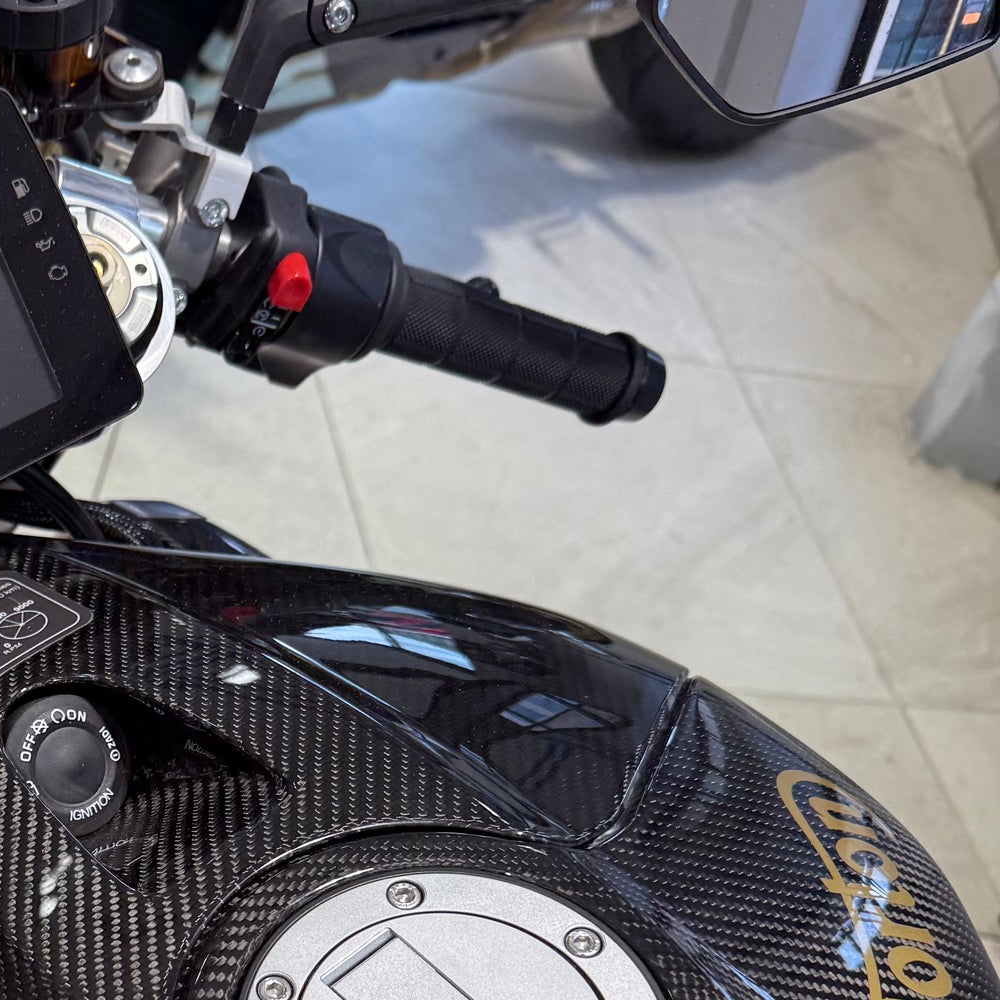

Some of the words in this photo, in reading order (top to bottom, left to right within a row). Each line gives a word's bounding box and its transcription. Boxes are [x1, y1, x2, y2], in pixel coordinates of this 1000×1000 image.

[3, 585, 21, 596] km)
[13, 599, 34, 612] 9000
[66, 709, 87, 722] ON
[98, 725, 117, 749] ZADI
[20, 733, 36, 763] OFF
[69, 787, 114, 821] IGNITION
